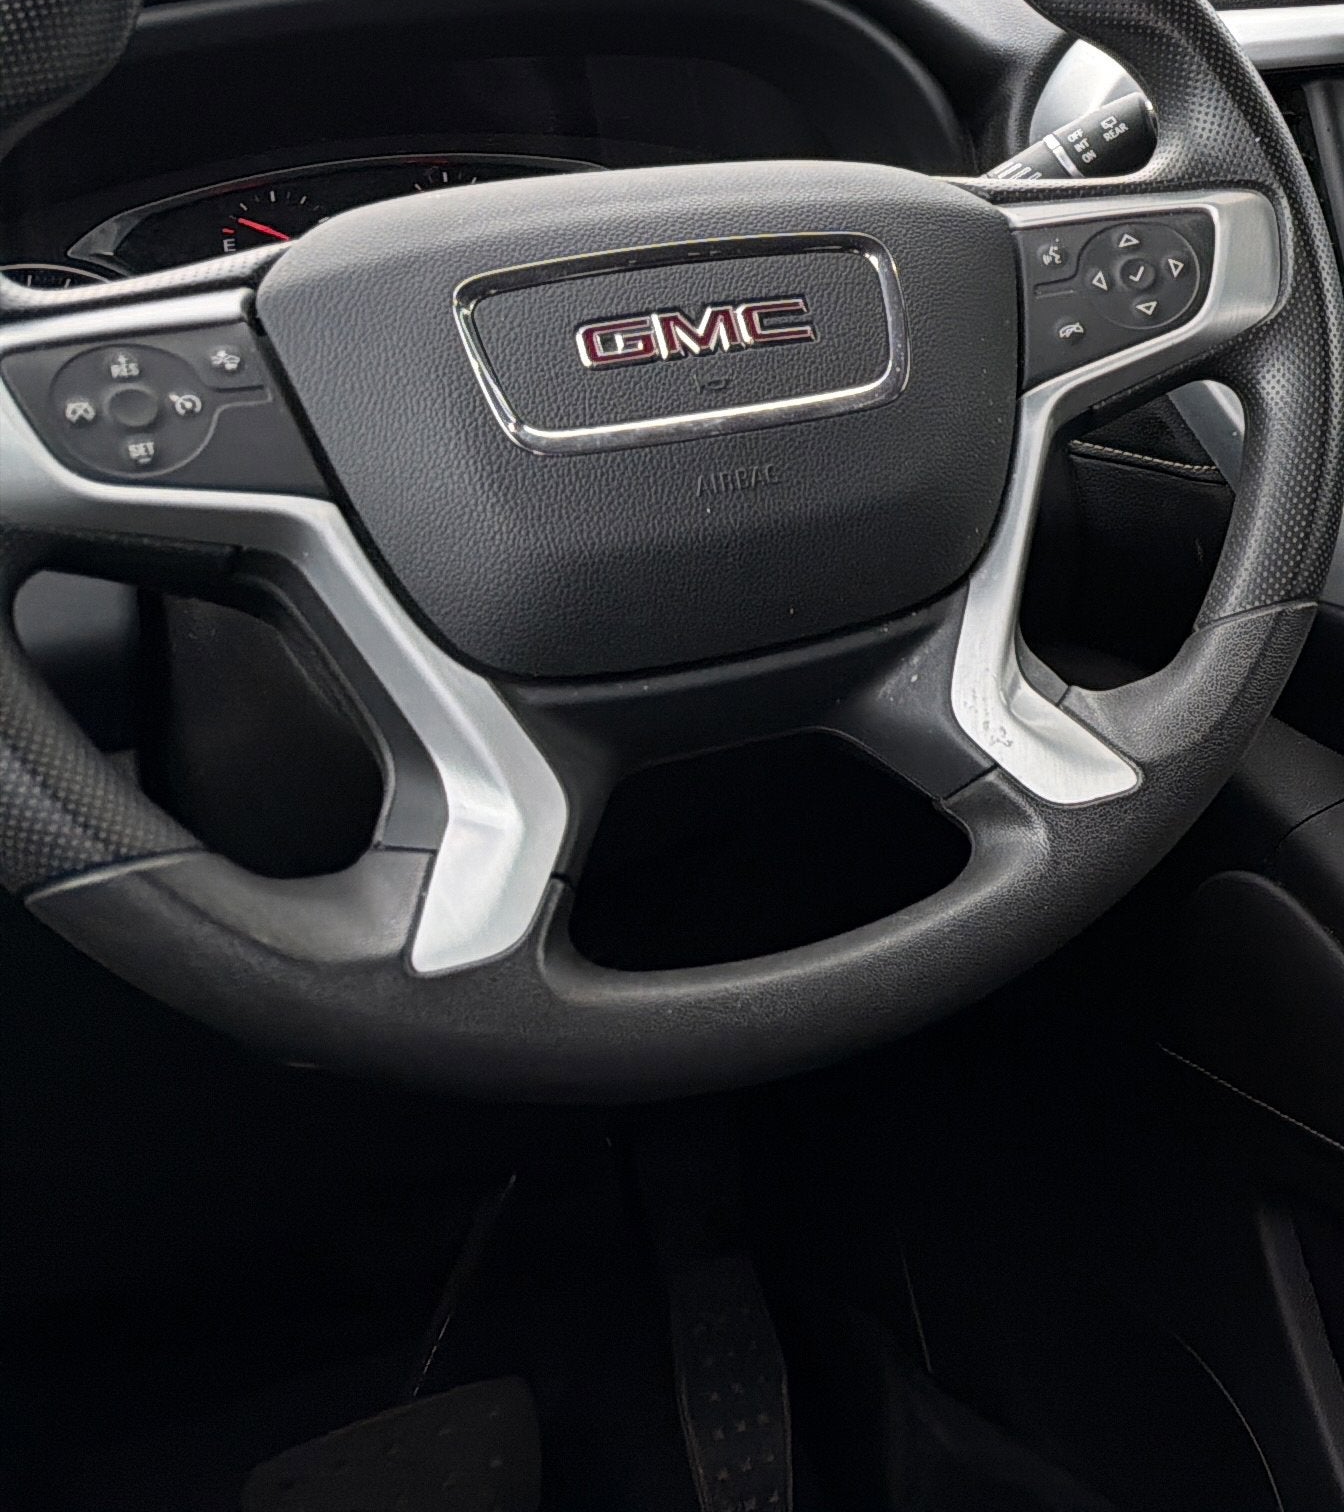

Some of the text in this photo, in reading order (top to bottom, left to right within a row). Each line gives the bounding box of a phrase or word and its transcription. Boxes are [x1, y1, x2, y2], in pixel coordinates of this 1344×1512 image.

[1067, 128, 1084, 143] OFF
[1103, 123, 1129, 141] REAR
[1074, 137, 1090, 152] INT
[222, 238, 236, 252] E
[575, 295, 818, 370] GMC
[111, 361, 140, 378] RES
[128, 441, 155, 460] SET
